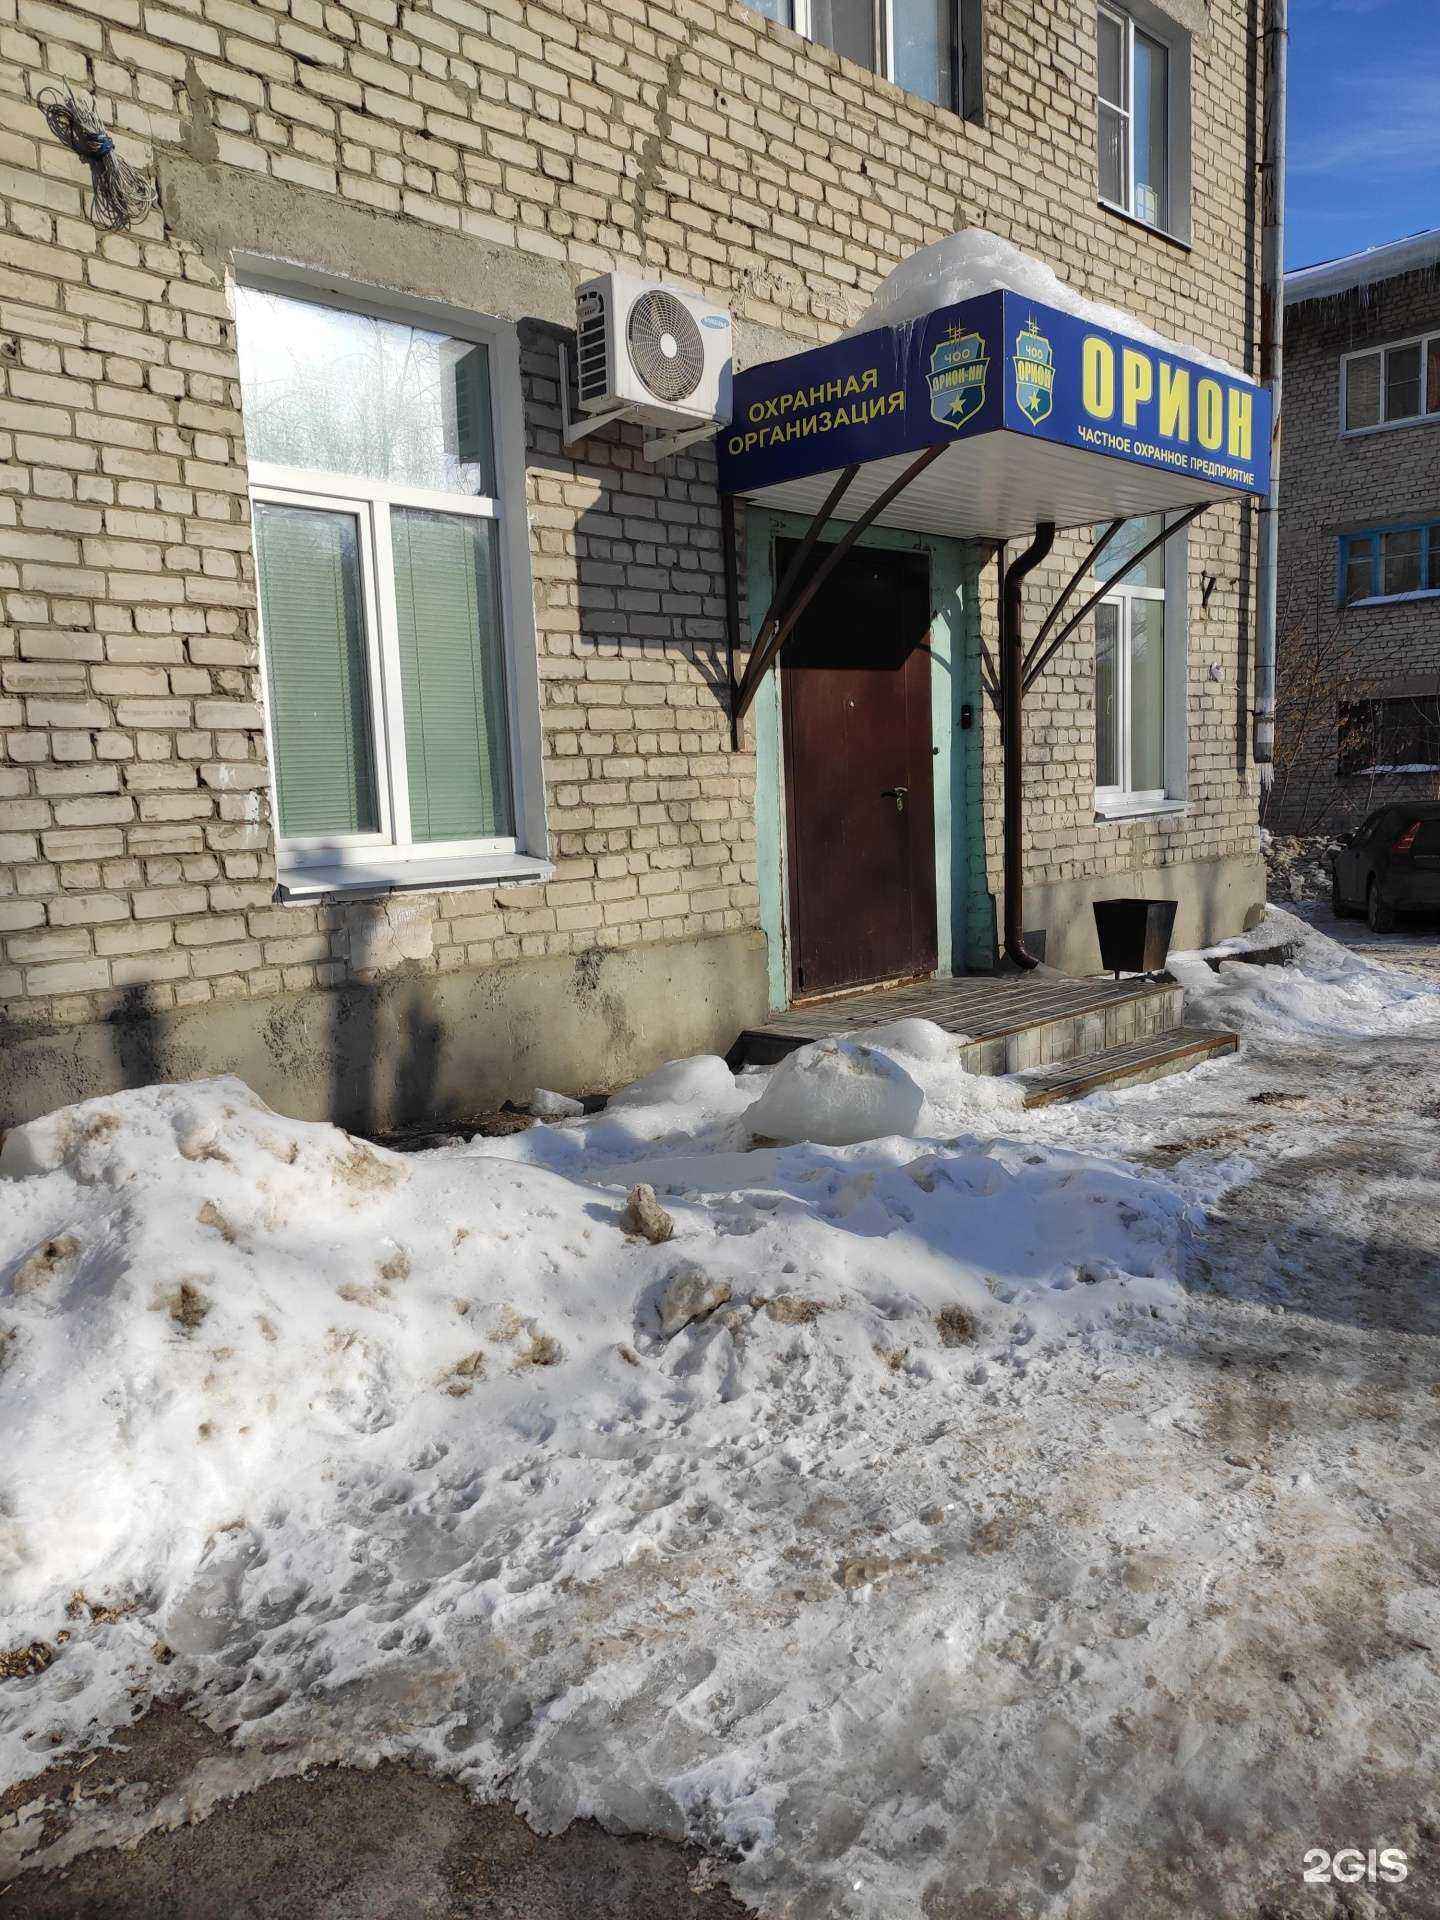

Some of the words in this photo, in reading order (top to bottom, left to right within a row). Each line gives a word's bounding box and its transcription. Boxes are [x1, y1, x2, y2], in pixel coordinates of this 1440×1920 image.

[749, 368, 878, 422] ОХРАННАЯ
[1018, 360, 1051, 389] ОРИОН
[1083, 337, 1252, 460] ОРИОН
[729, 391, 905, 455] ОРГАНИЗАЦИЯ
[1078, 425, 1131, 452] ЧАСТНОЕ
[1134, 441, 1188, 469] ОХРАННОЕ
[1190, 456, 1255, 486] ПРЕДПРИЯТИЕ
